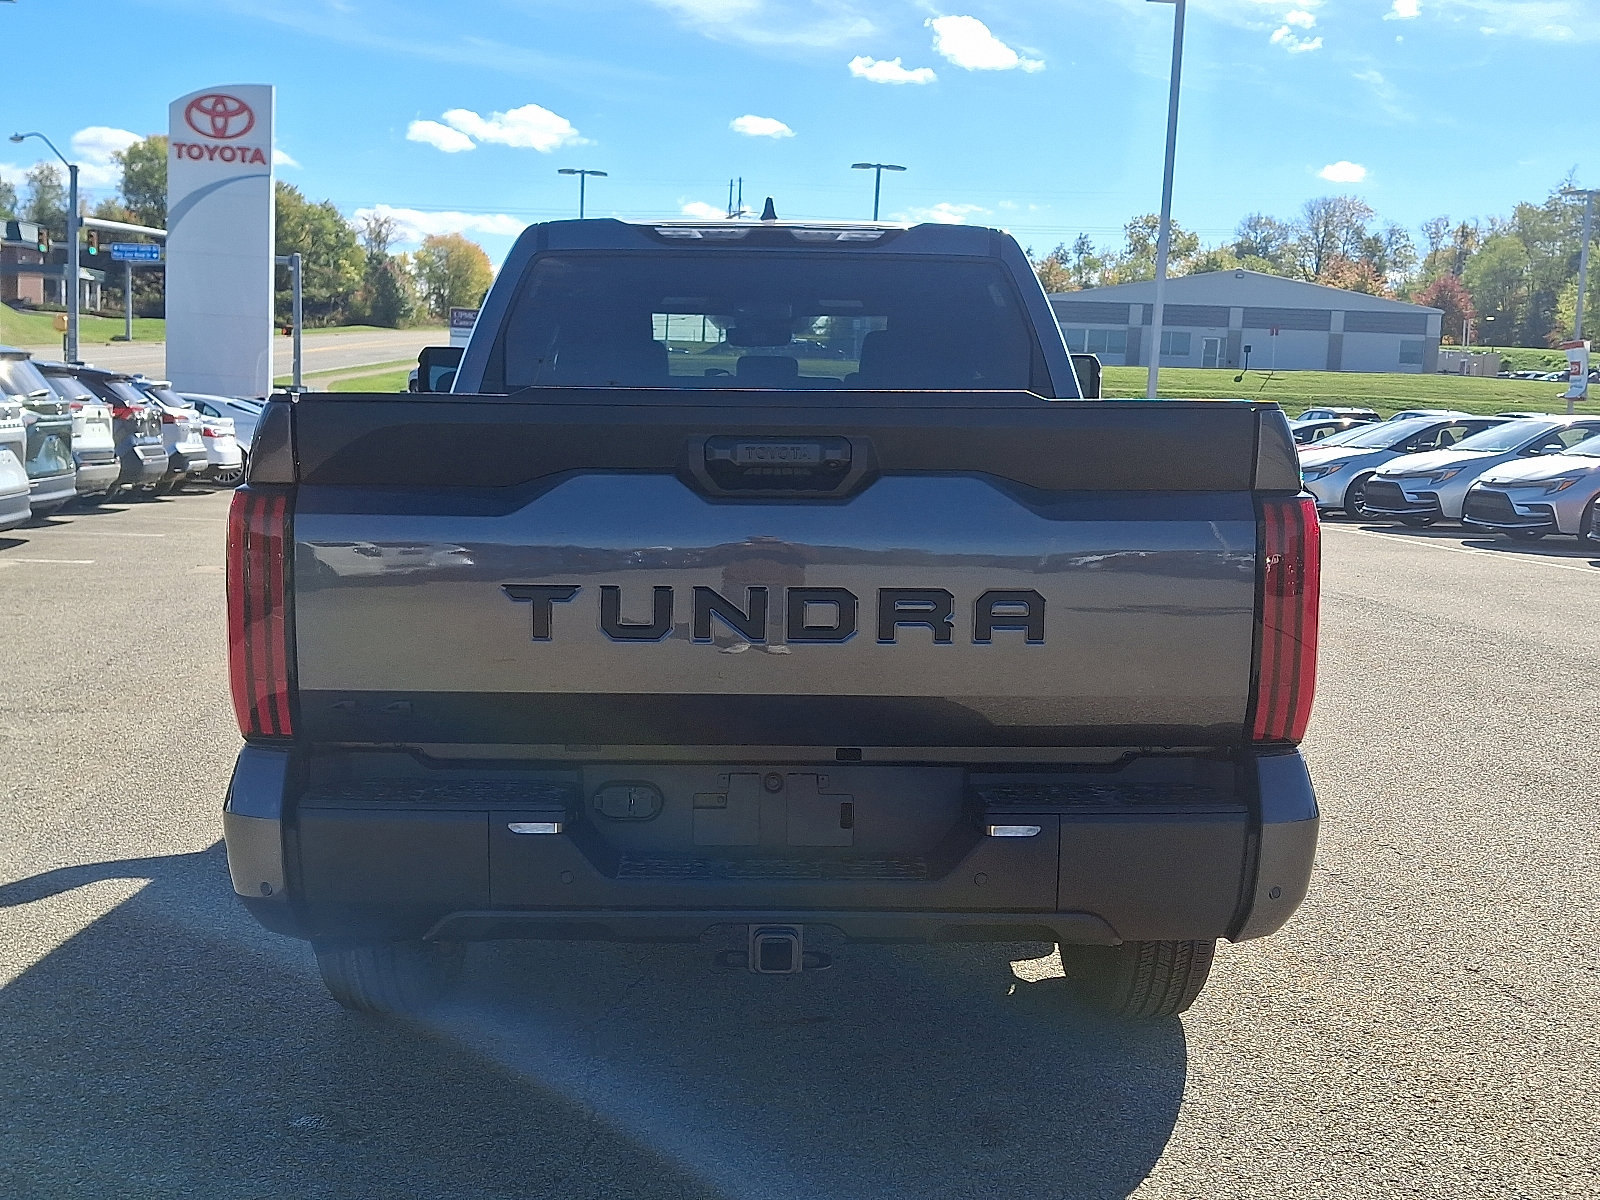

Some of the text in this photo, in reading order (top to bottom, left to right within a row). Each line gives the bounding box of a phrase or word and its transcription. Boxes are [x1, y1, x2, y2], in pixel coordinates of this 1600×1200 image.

[172, 142, 266, 165] TOYOTA
[745, 446, 811, 460] TOYOTA
[501, 584, 1047, 645] TUNDRA
